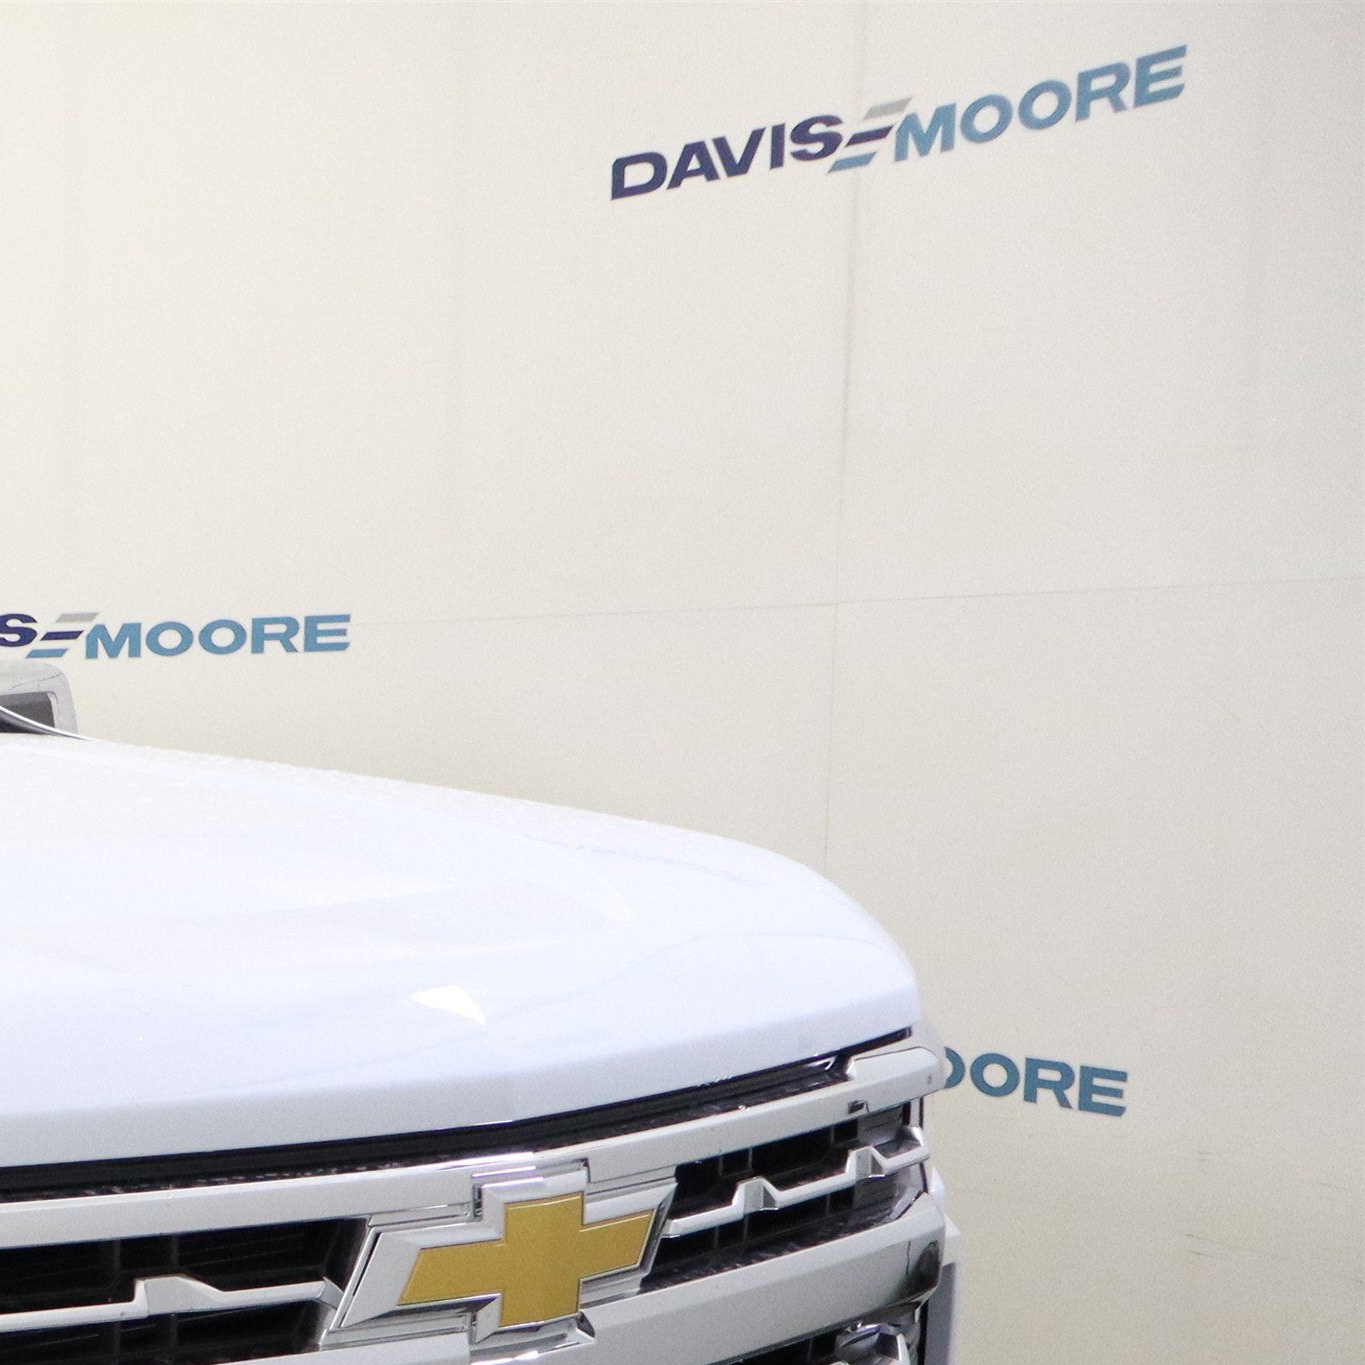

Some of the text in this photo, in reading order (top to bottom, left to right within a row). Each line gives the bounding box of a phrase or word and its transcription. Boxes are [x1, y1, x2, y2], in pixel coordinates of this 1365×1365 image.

[610, 44, 1189, 201] DAVIS MOORE
[85, 613, 352, 660] MOORE
